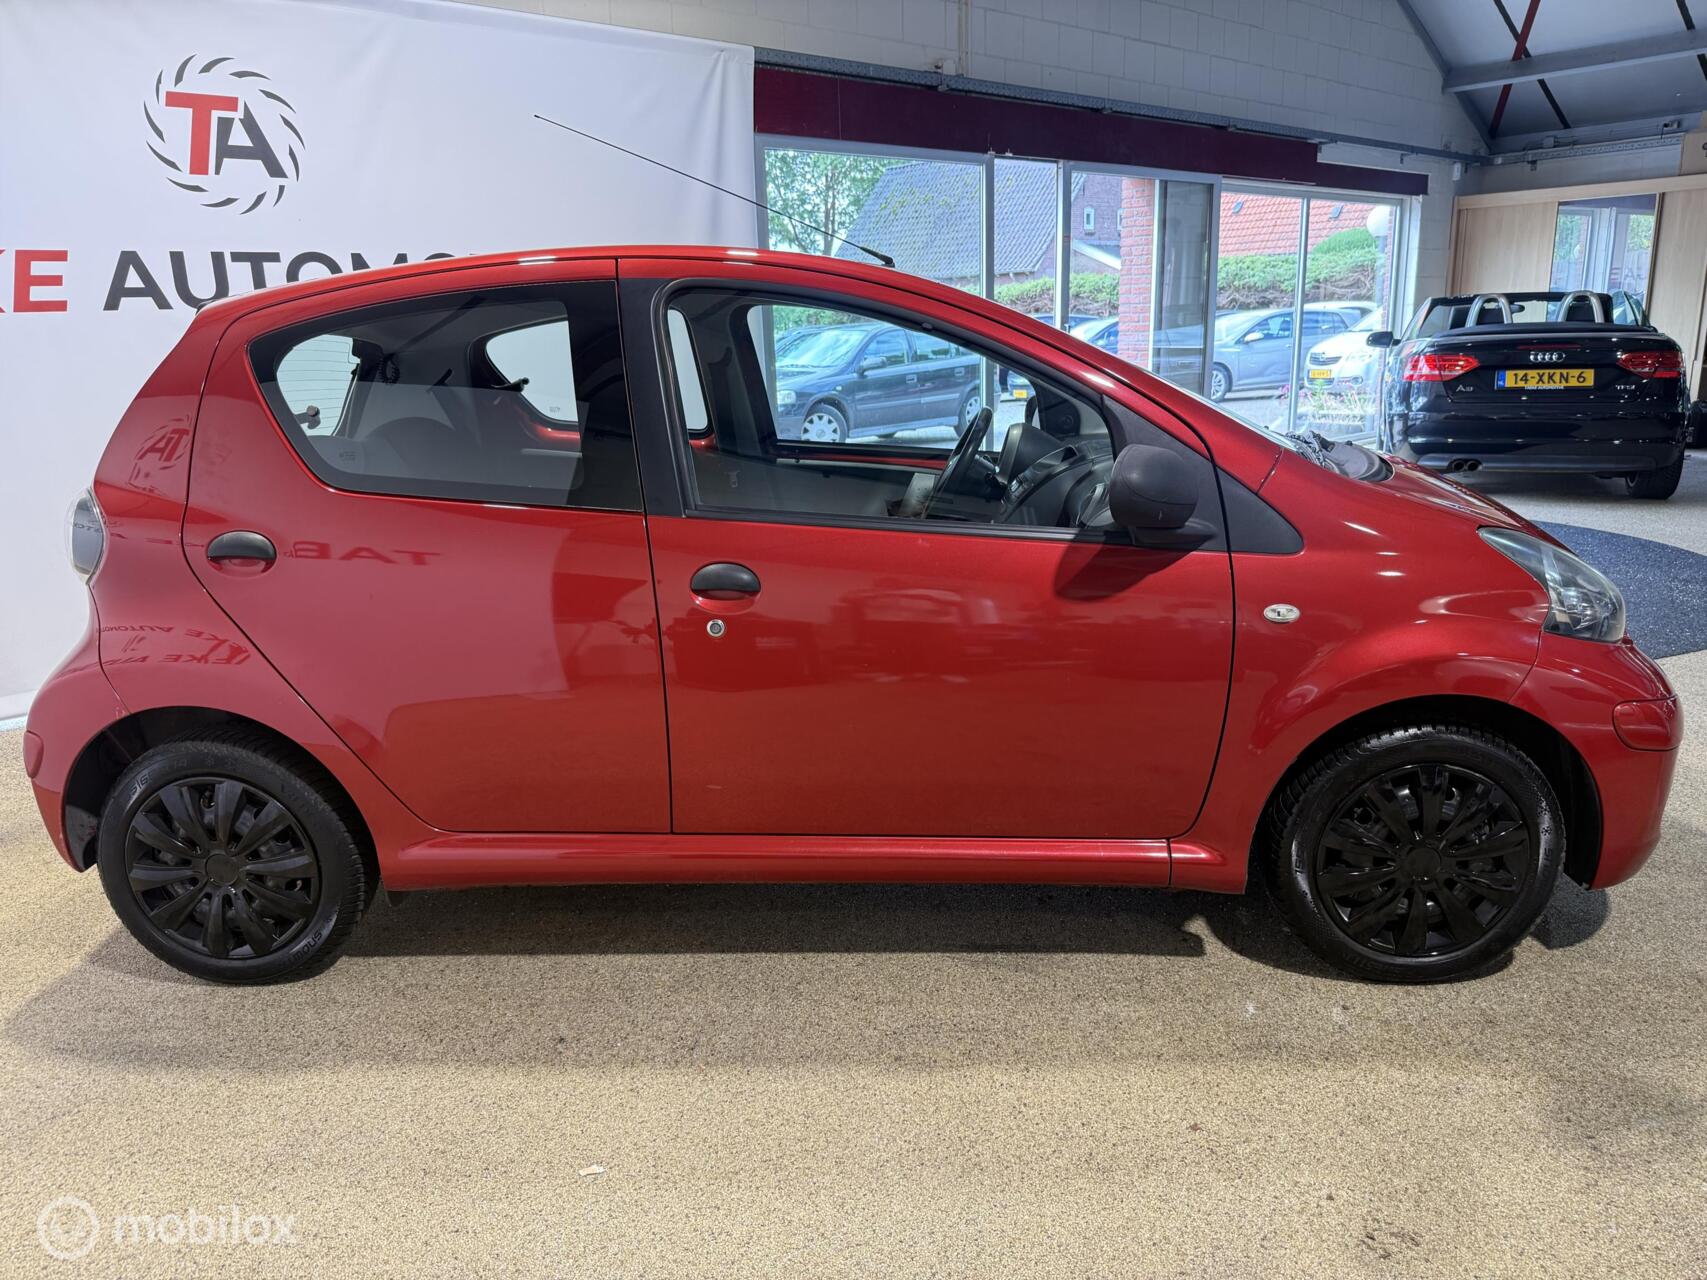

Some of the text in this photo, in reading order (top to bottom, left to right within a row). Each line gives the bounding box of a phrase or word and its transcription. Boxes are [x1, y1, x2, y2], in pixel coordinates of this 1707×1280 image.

[165, 91, 288, 179] TA
[0, 249, 480, 313] E AUTO
[1513, 372, 1586, 384] 14-XKN-6
